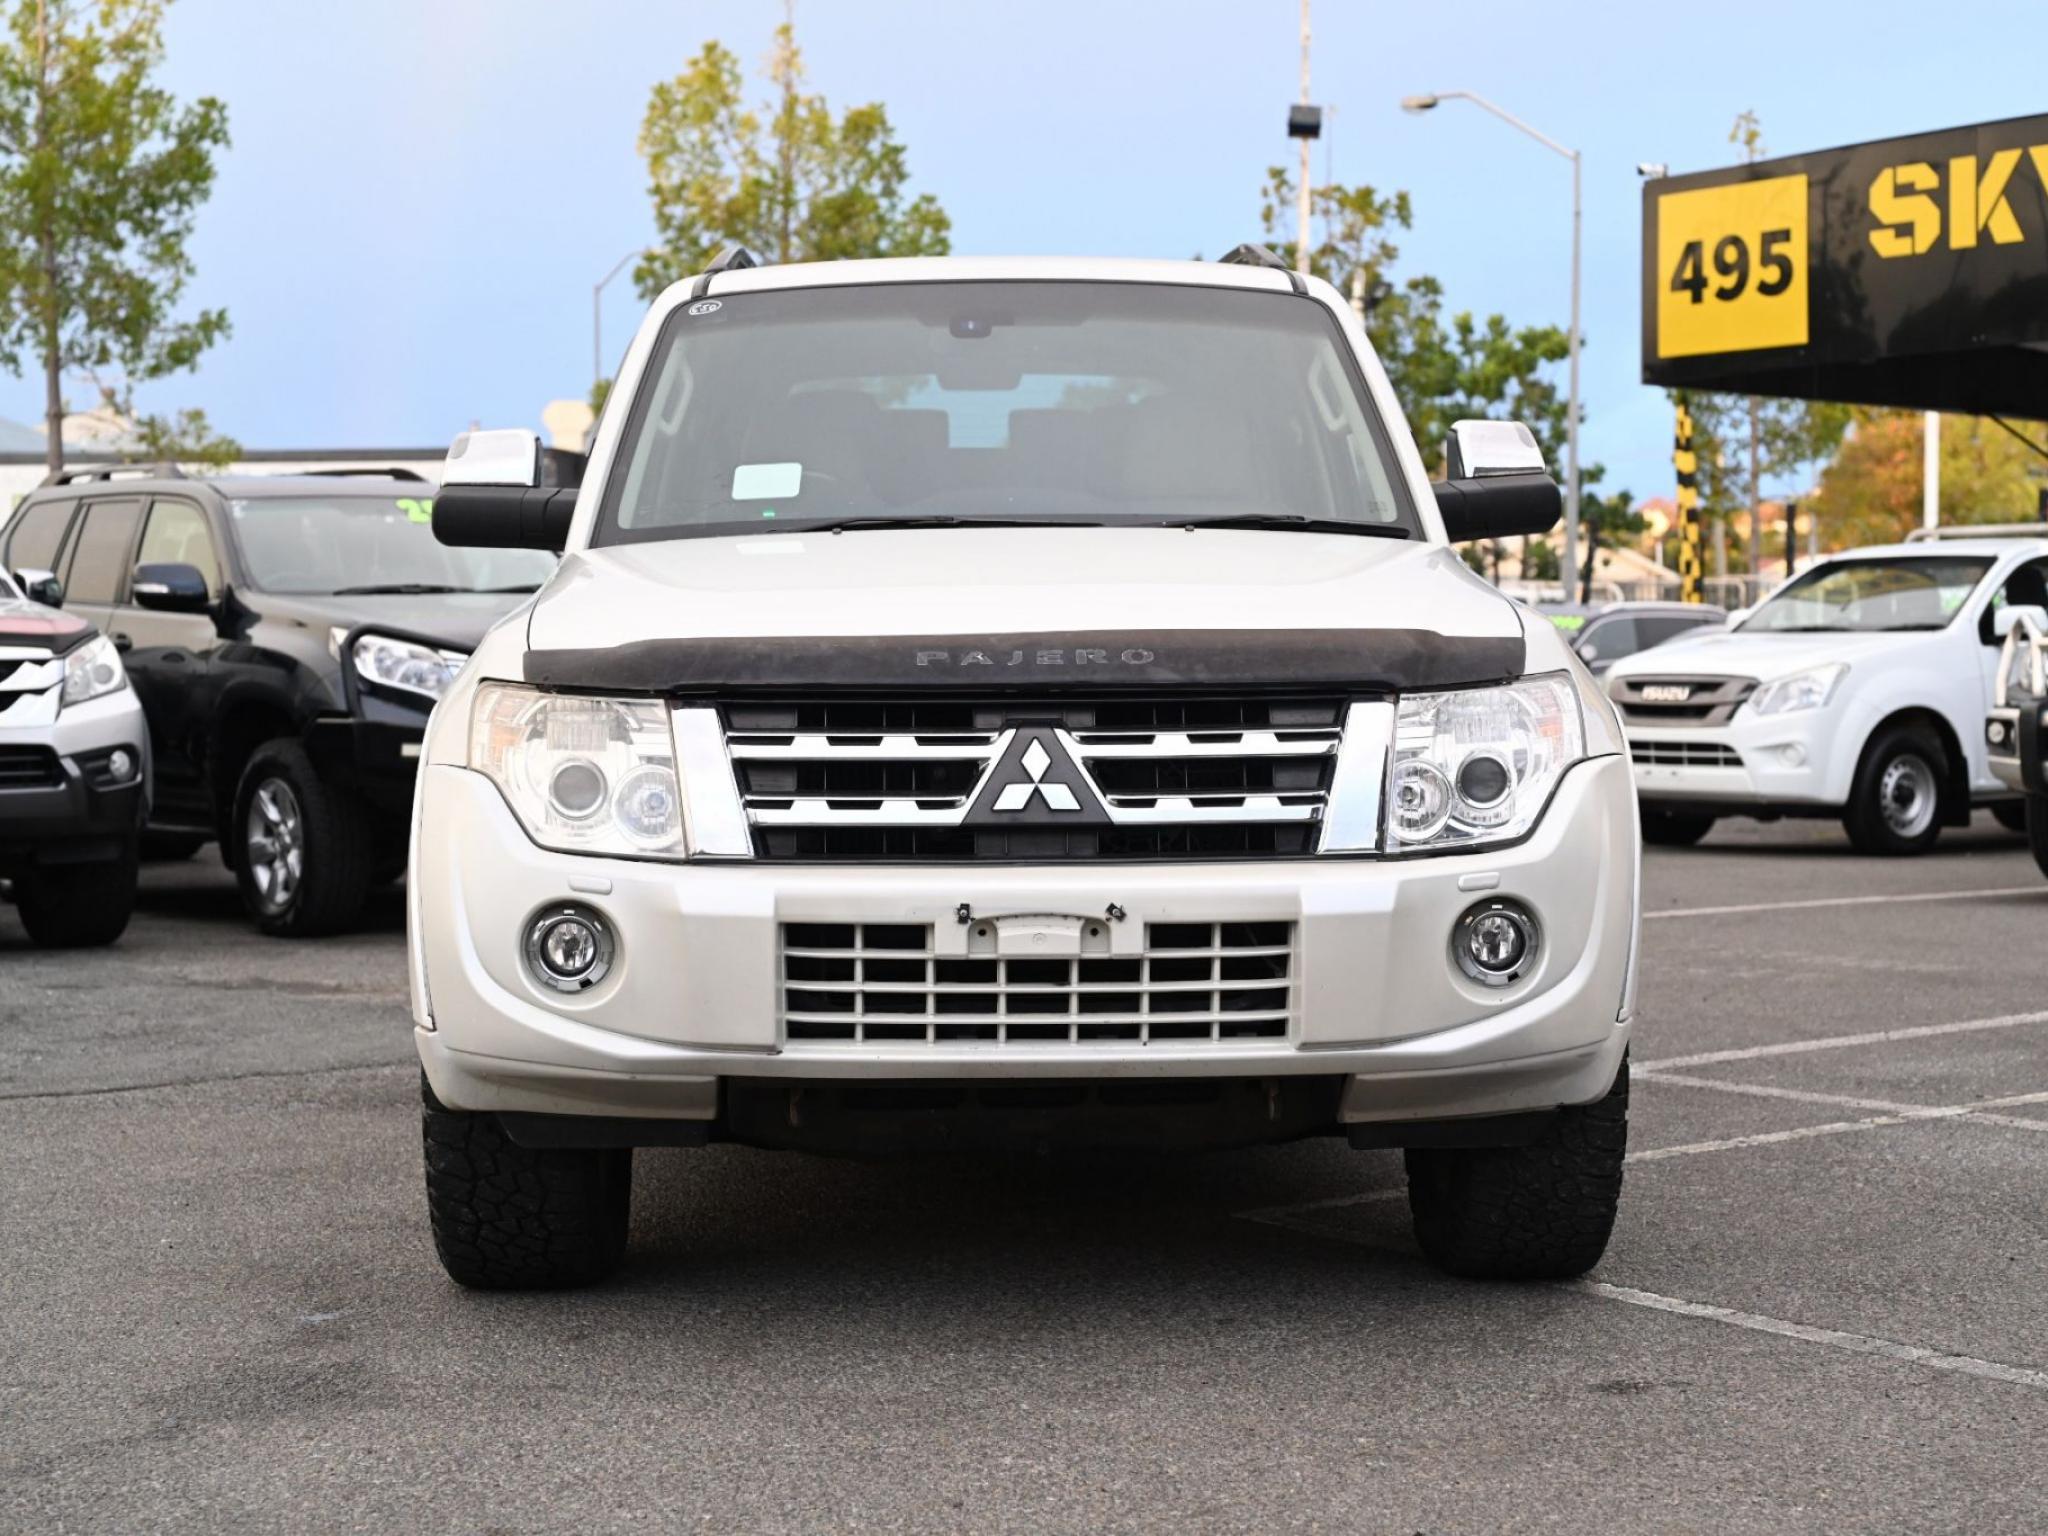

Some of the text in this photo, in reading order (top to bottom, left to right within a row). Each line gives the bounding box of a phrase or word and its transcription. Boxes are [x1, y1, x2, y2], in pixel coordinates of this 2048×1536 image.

[1869, 144, 2048, 258] SK
[1670, 228, 1793, 304] 495
[916, 649, 1155, 666] PAJERO
